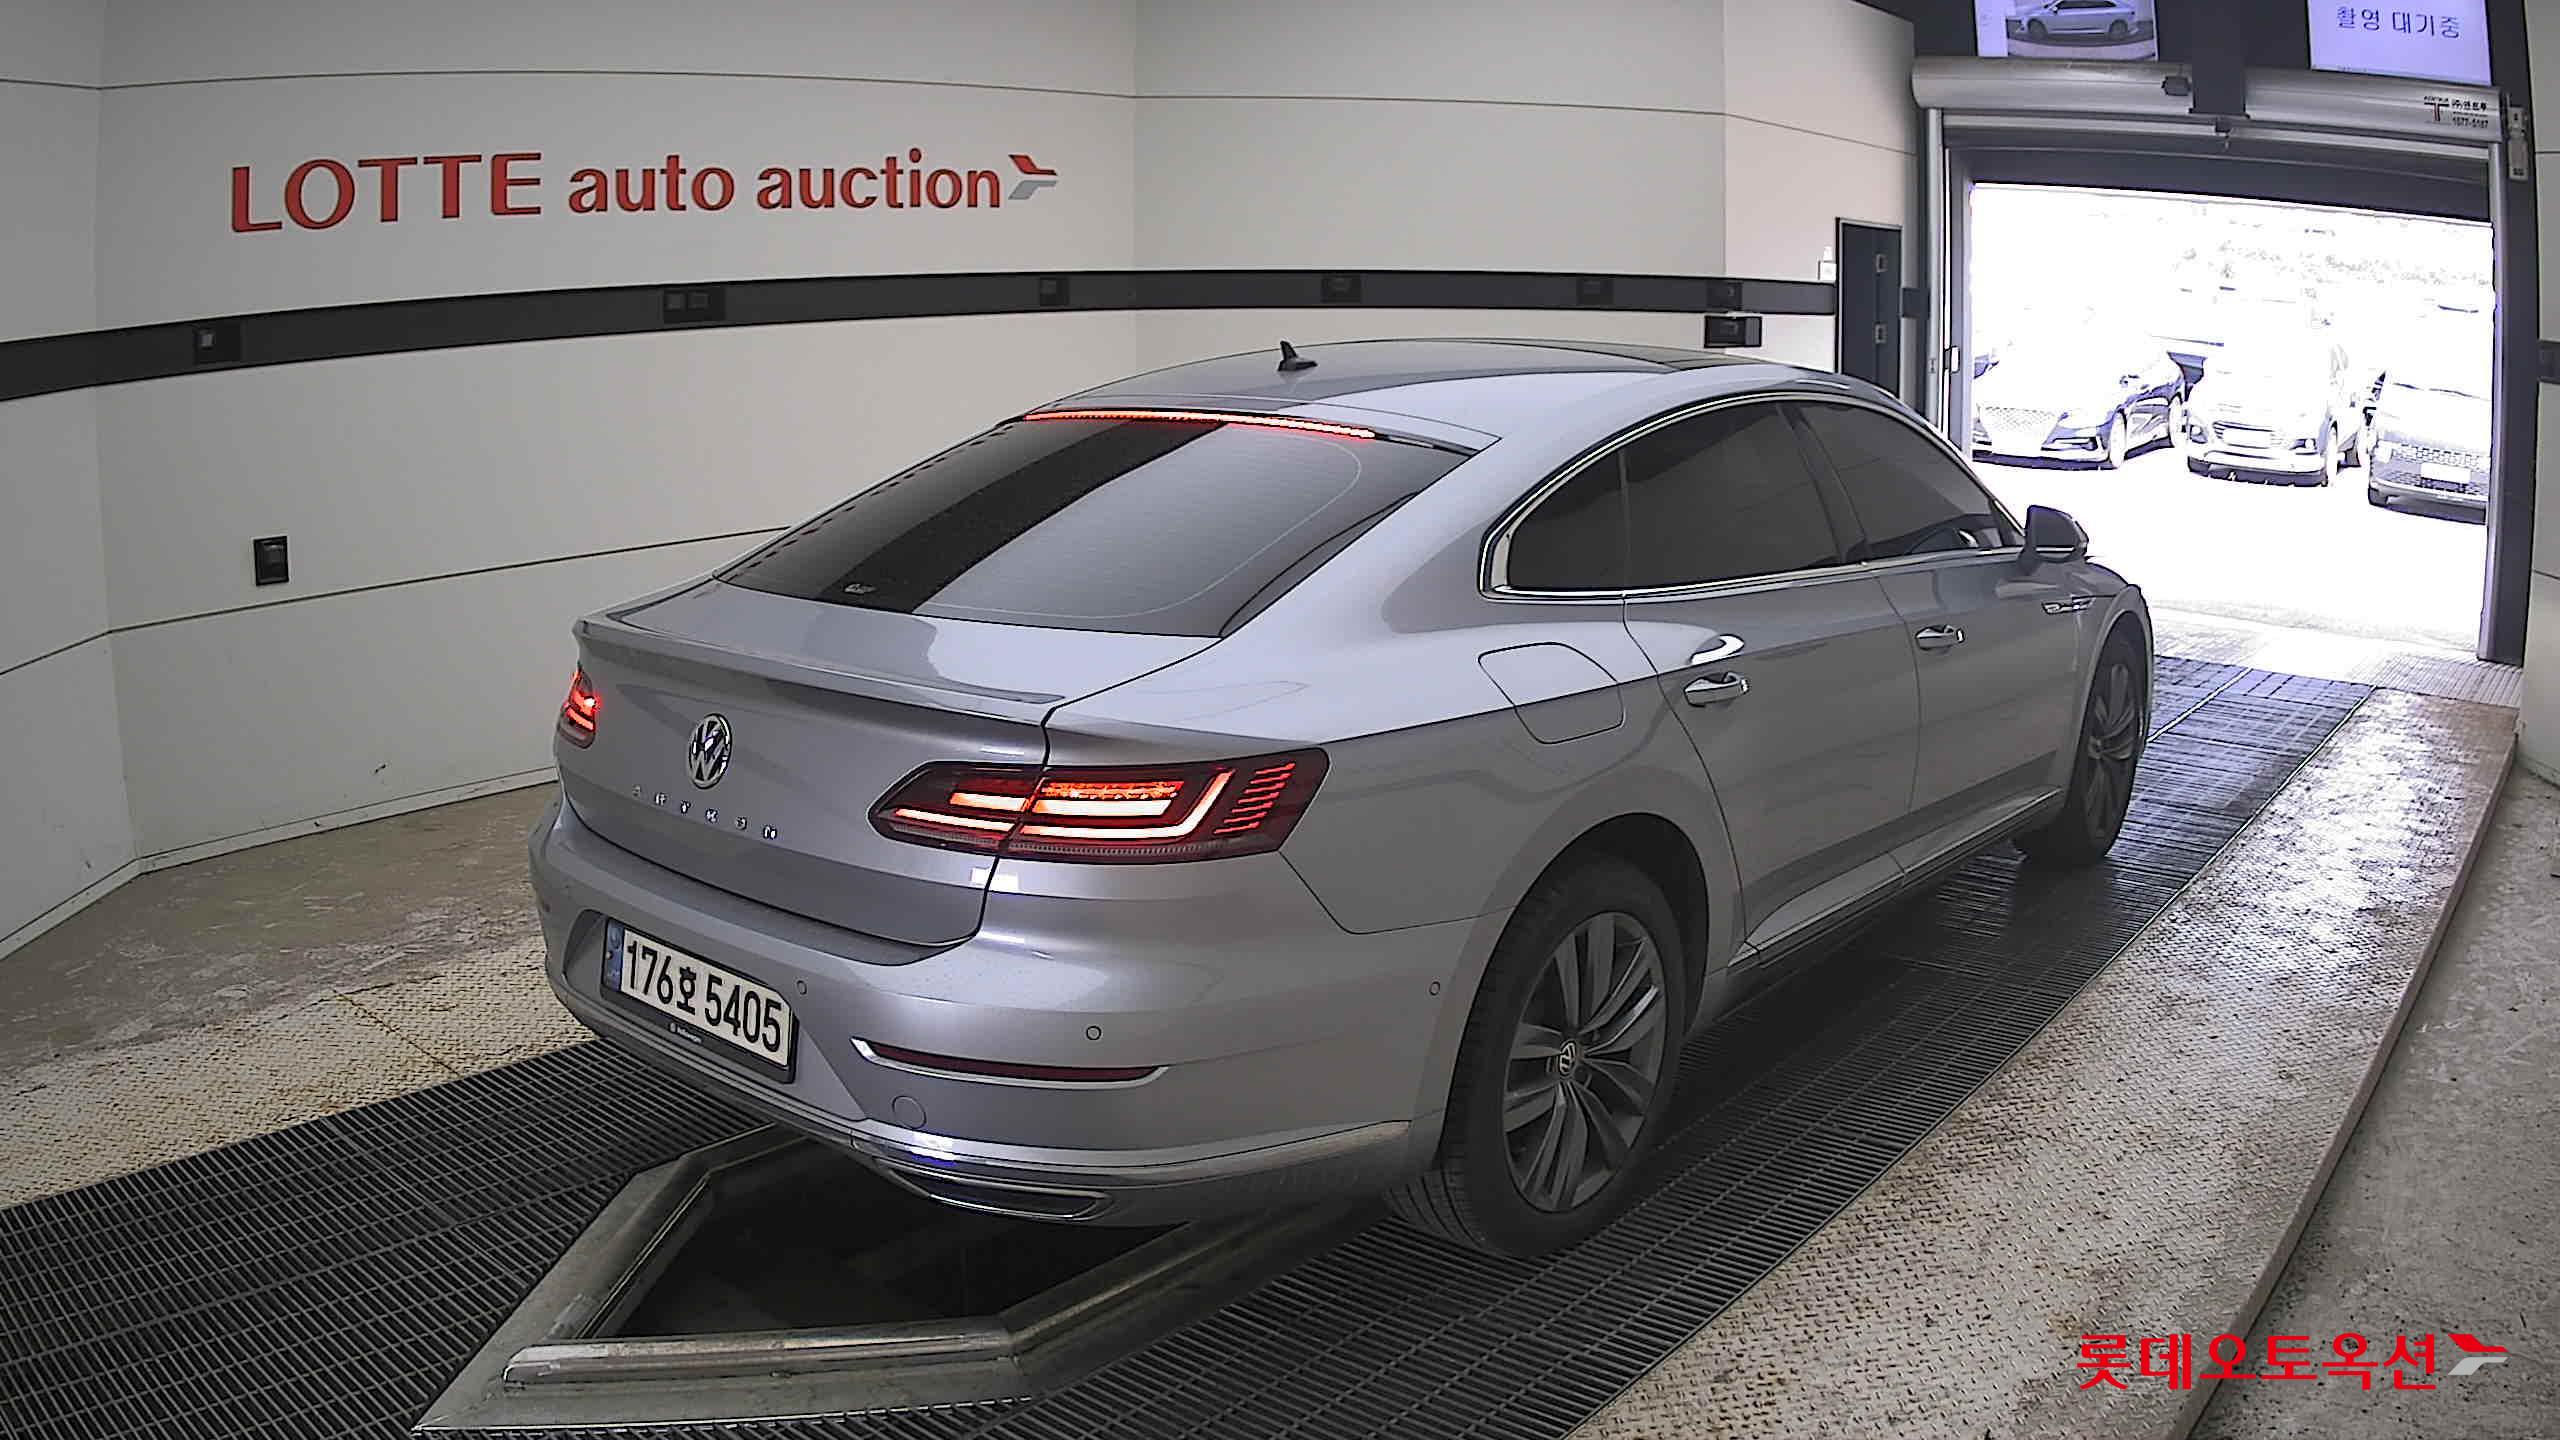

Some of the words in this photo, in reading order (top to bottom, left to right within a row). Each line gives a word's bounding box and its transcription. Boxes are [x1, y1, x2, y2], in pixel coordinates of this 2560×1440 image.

[2392, 11, 2460, 39] 대기중
[231, 153, 541, 234] LOTTE
[568, 154, 737, 213] auto
[758, 147, 1003, 211] auction
[704, 973, 782, 1053] 5405
